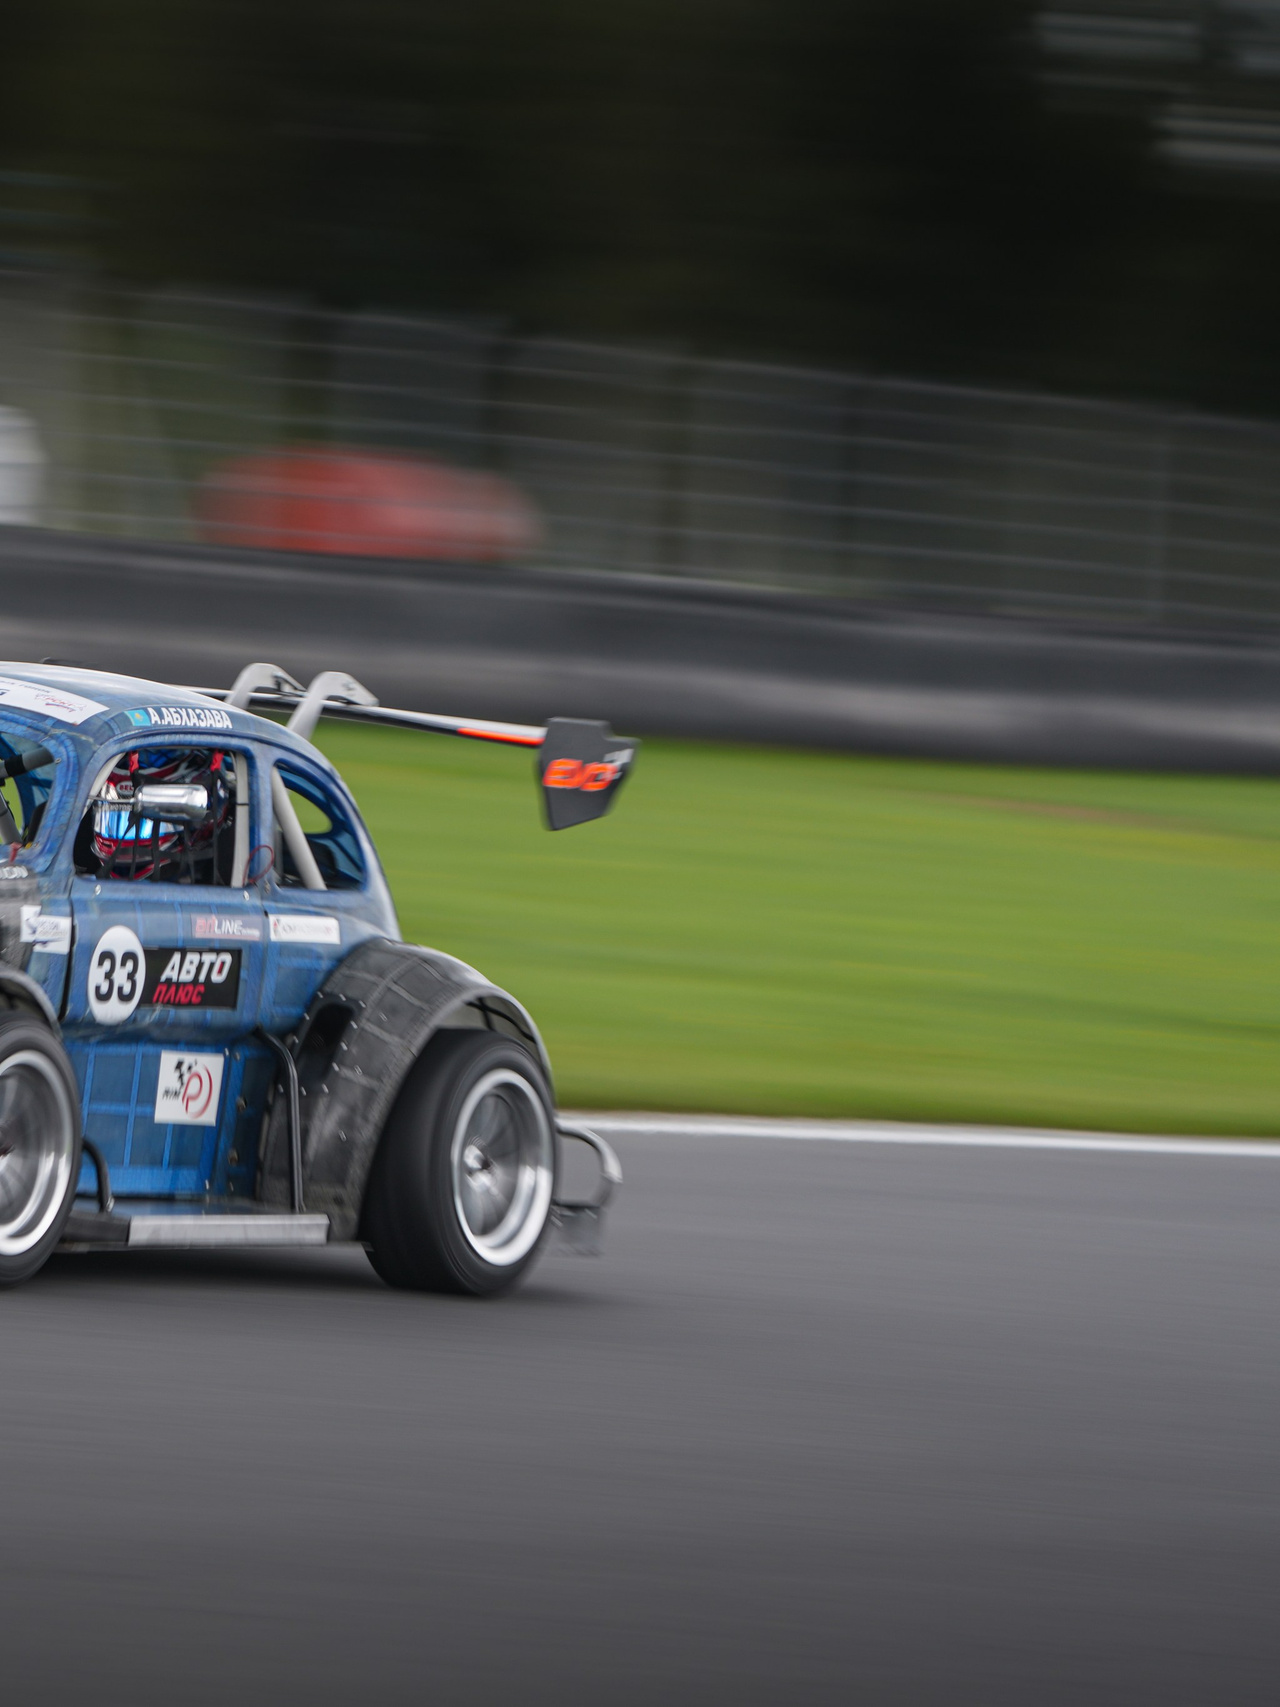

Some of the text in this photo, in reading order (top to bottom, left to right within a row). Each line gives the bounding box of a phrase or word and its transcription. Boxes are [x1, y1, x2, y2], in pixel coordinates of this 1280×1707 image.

[147, 706, 233, 729] А.АБХАЗАВА
[119, 783, 135, 792] BEL
[94, 949, 140, 1003] 33
[159, 951, 233, 984] АВТО
[152, 983, 205, 1005] ПЛЮС
